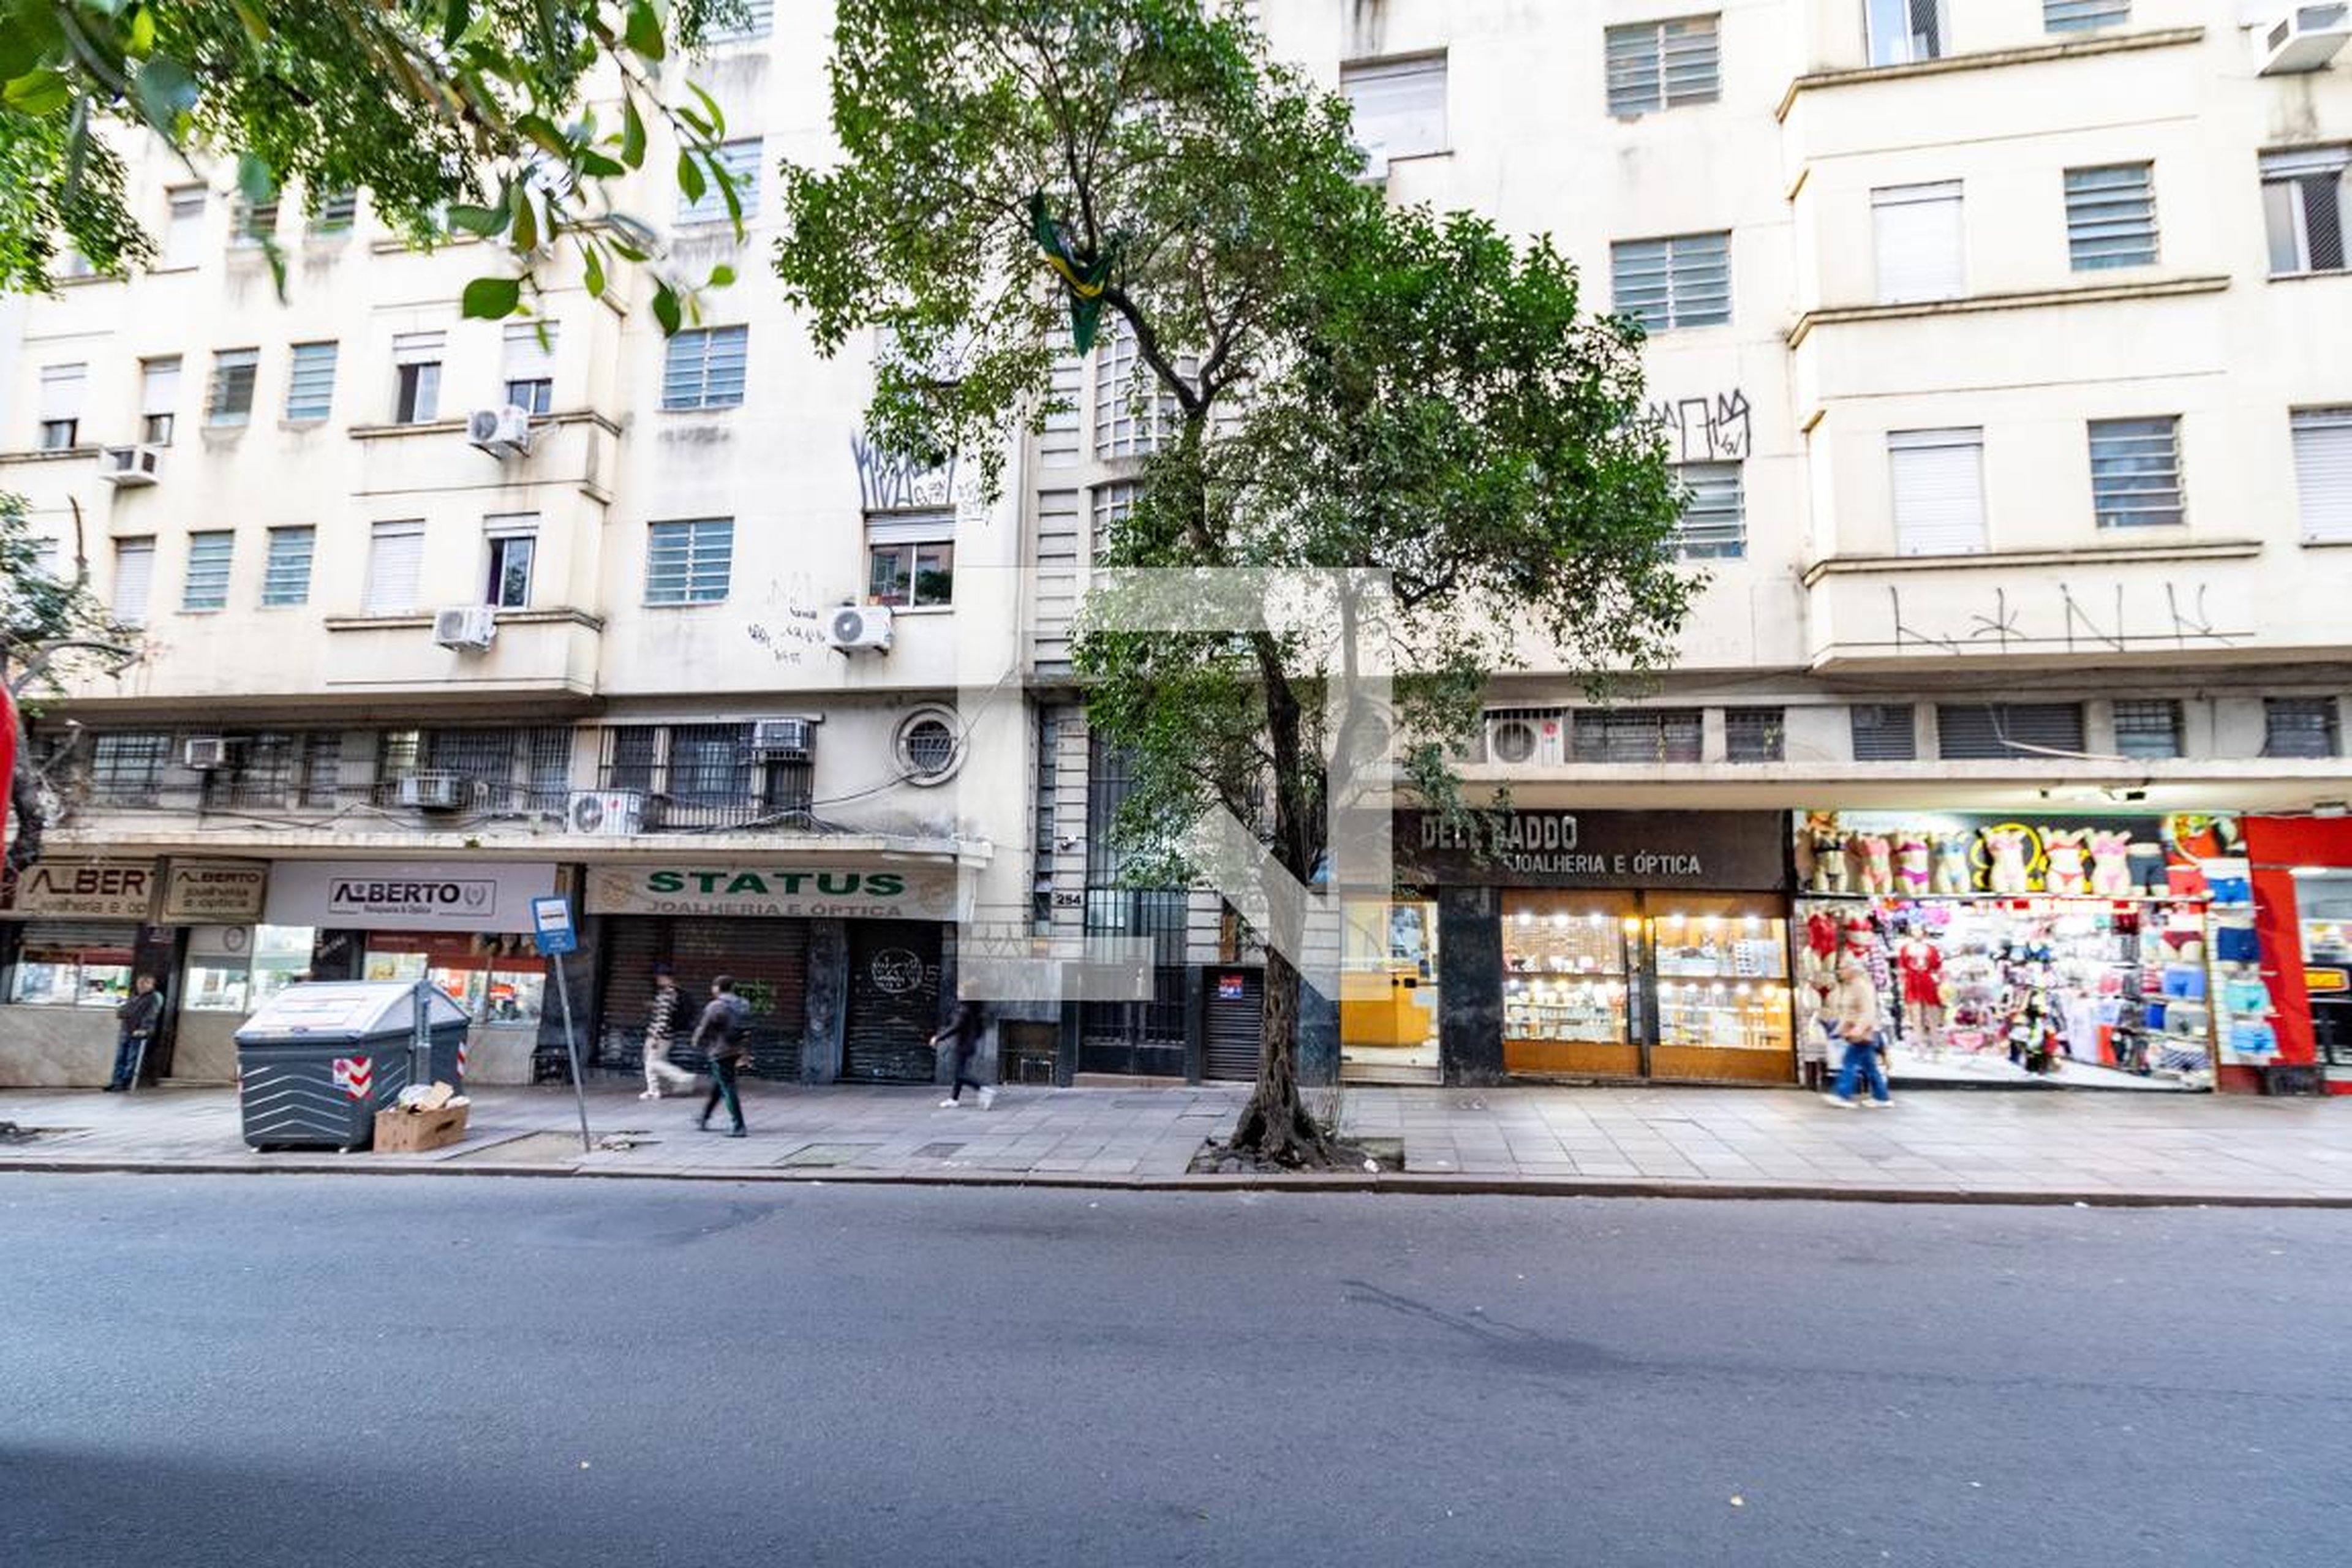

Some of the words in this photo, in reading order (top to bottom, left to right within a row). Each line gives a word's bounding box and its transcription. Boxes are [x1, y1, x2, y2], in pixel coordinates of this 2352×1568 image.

[1509, 855, 1605, 873] JOALHERIA
[1615, 856, 1626, 873] E
[1634, 850, 1701, 874] ÓPTICA
[28, 869, 155, 895] ALBER
[176, 872, 260, 883] ALBERTO
[647, 871, 905, 896] STATUS
[334, 883, 460, 903] ALBERTO
[1057, 894, 1081, 905] 254
[647, 901, 778, 916] JOALHERIA
[788, 903, 801, 915] E
